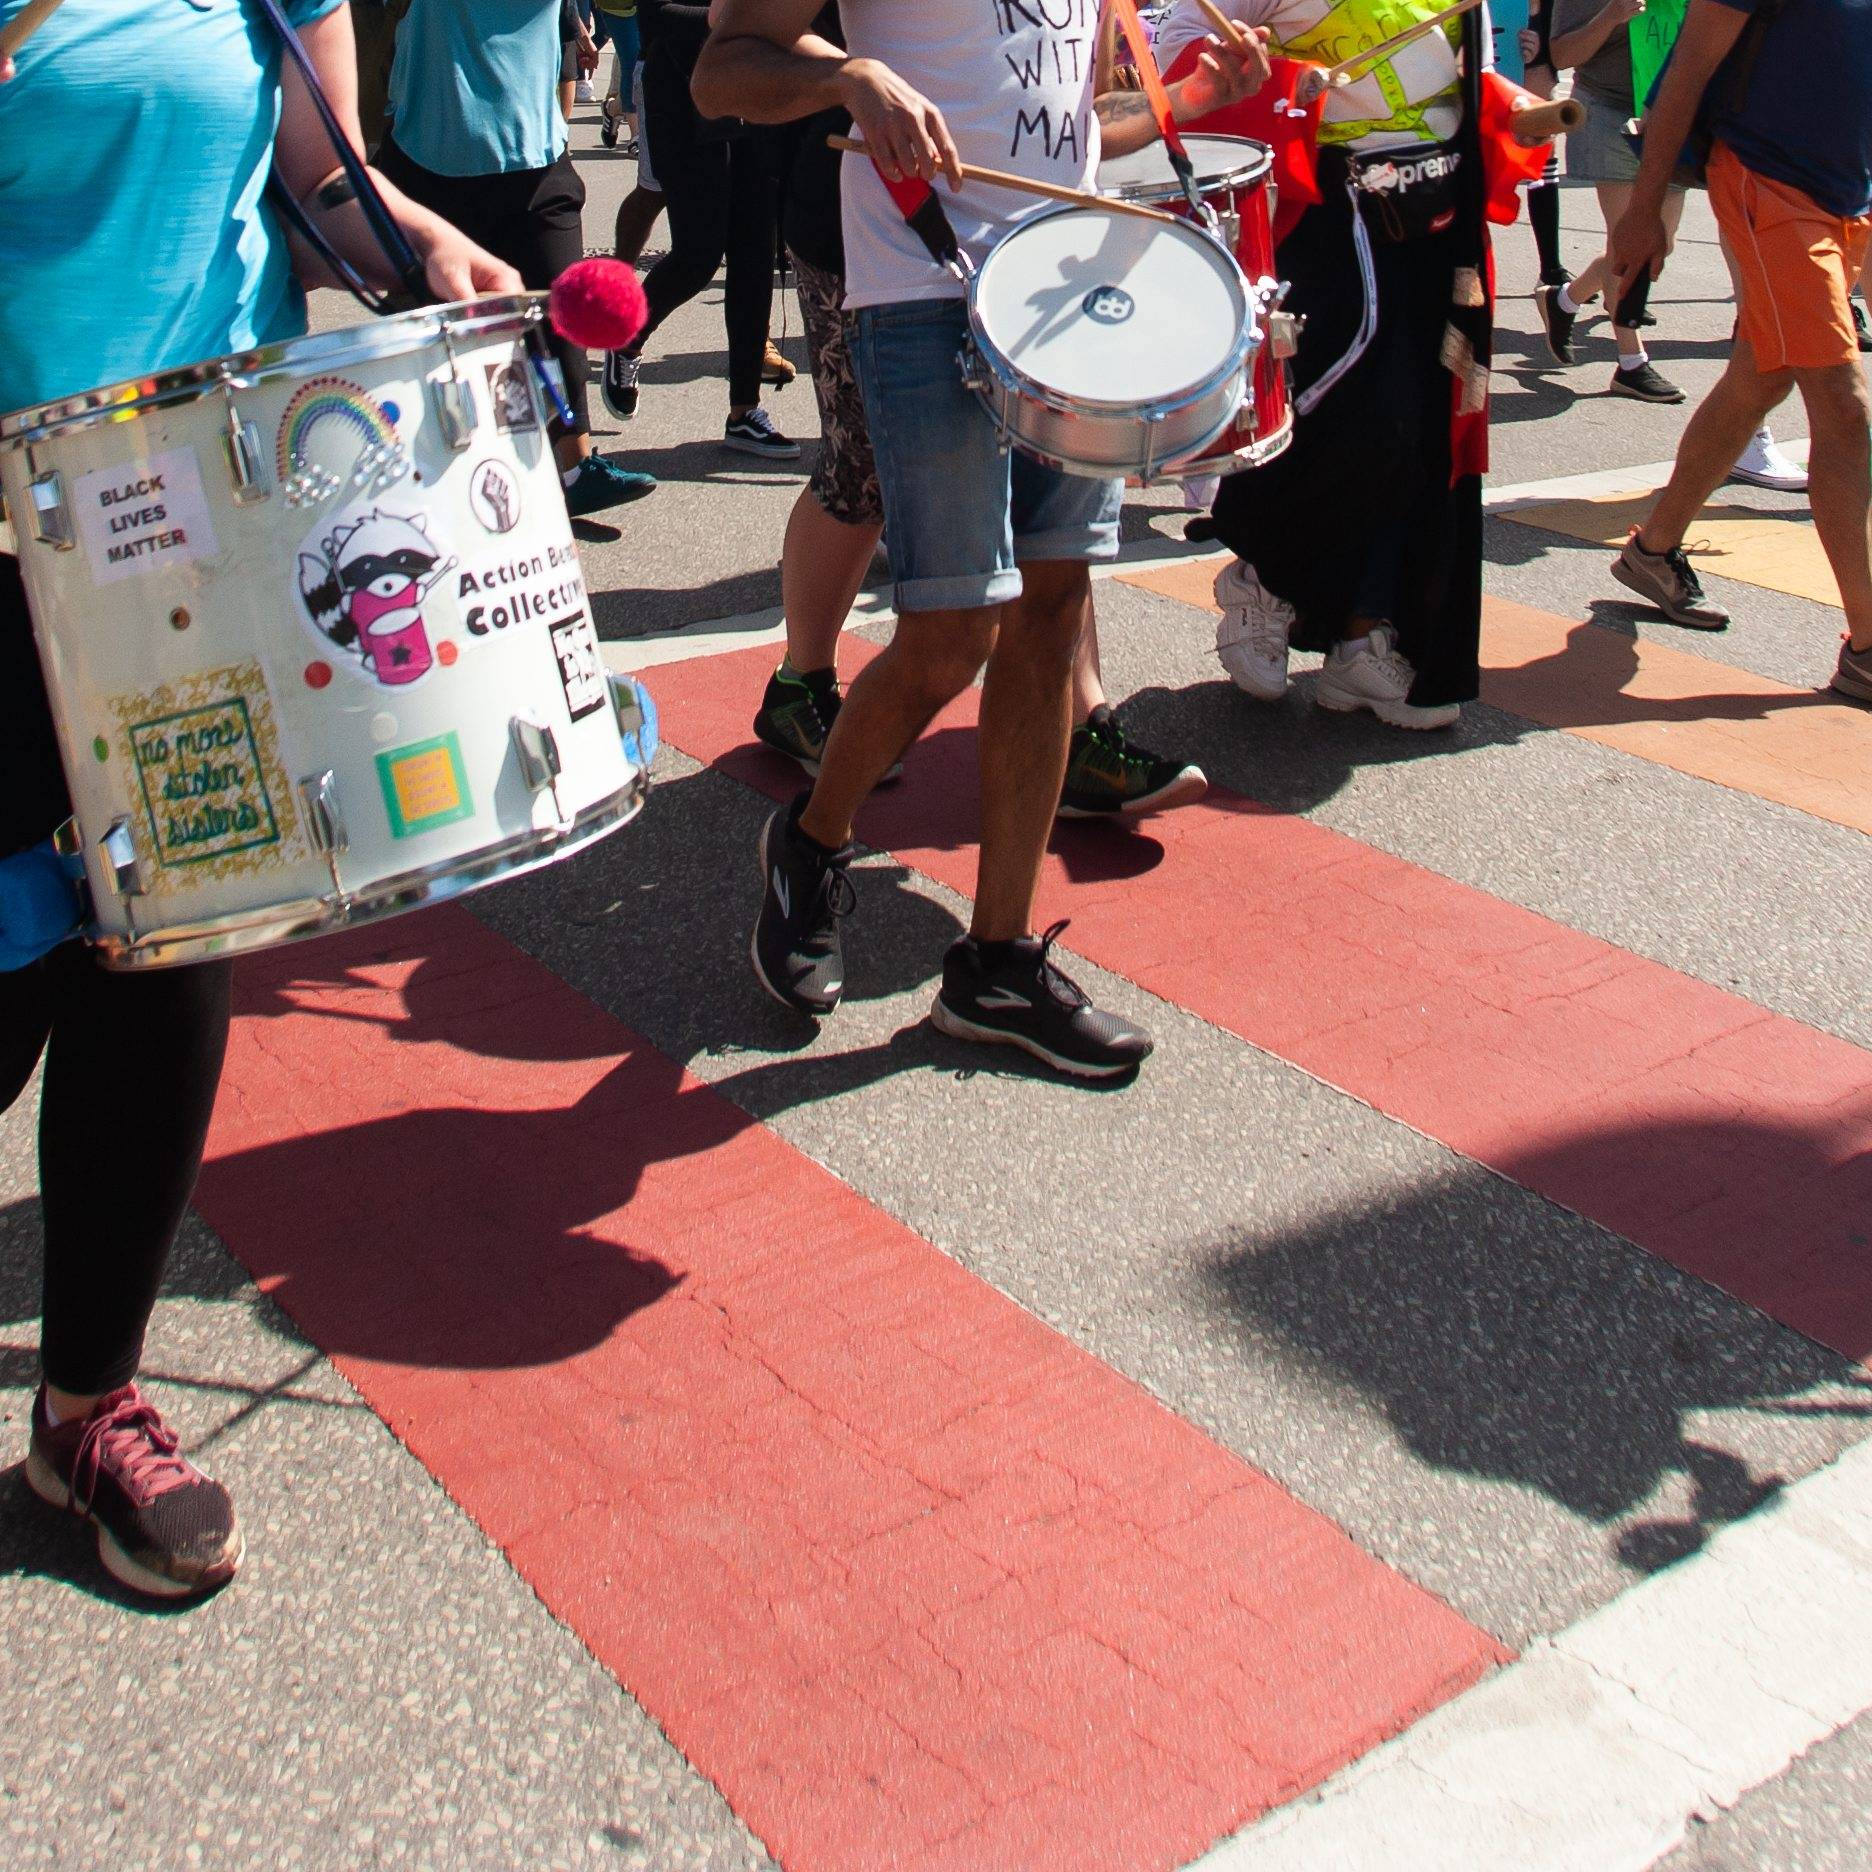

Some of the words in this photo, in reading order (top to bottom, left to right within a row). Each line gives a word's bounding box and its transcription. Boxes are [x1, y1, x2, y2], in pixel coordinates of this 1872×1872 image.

[1397, 152, 1461, 194] prem
[99, 474, 166, 507] BLACK
[109, 504, 167, 534] LIVES
[107, 528, 186, 564] MATTER
[458, 552, 543, 599] Action
[466, 578, 583, 637] Collecti
